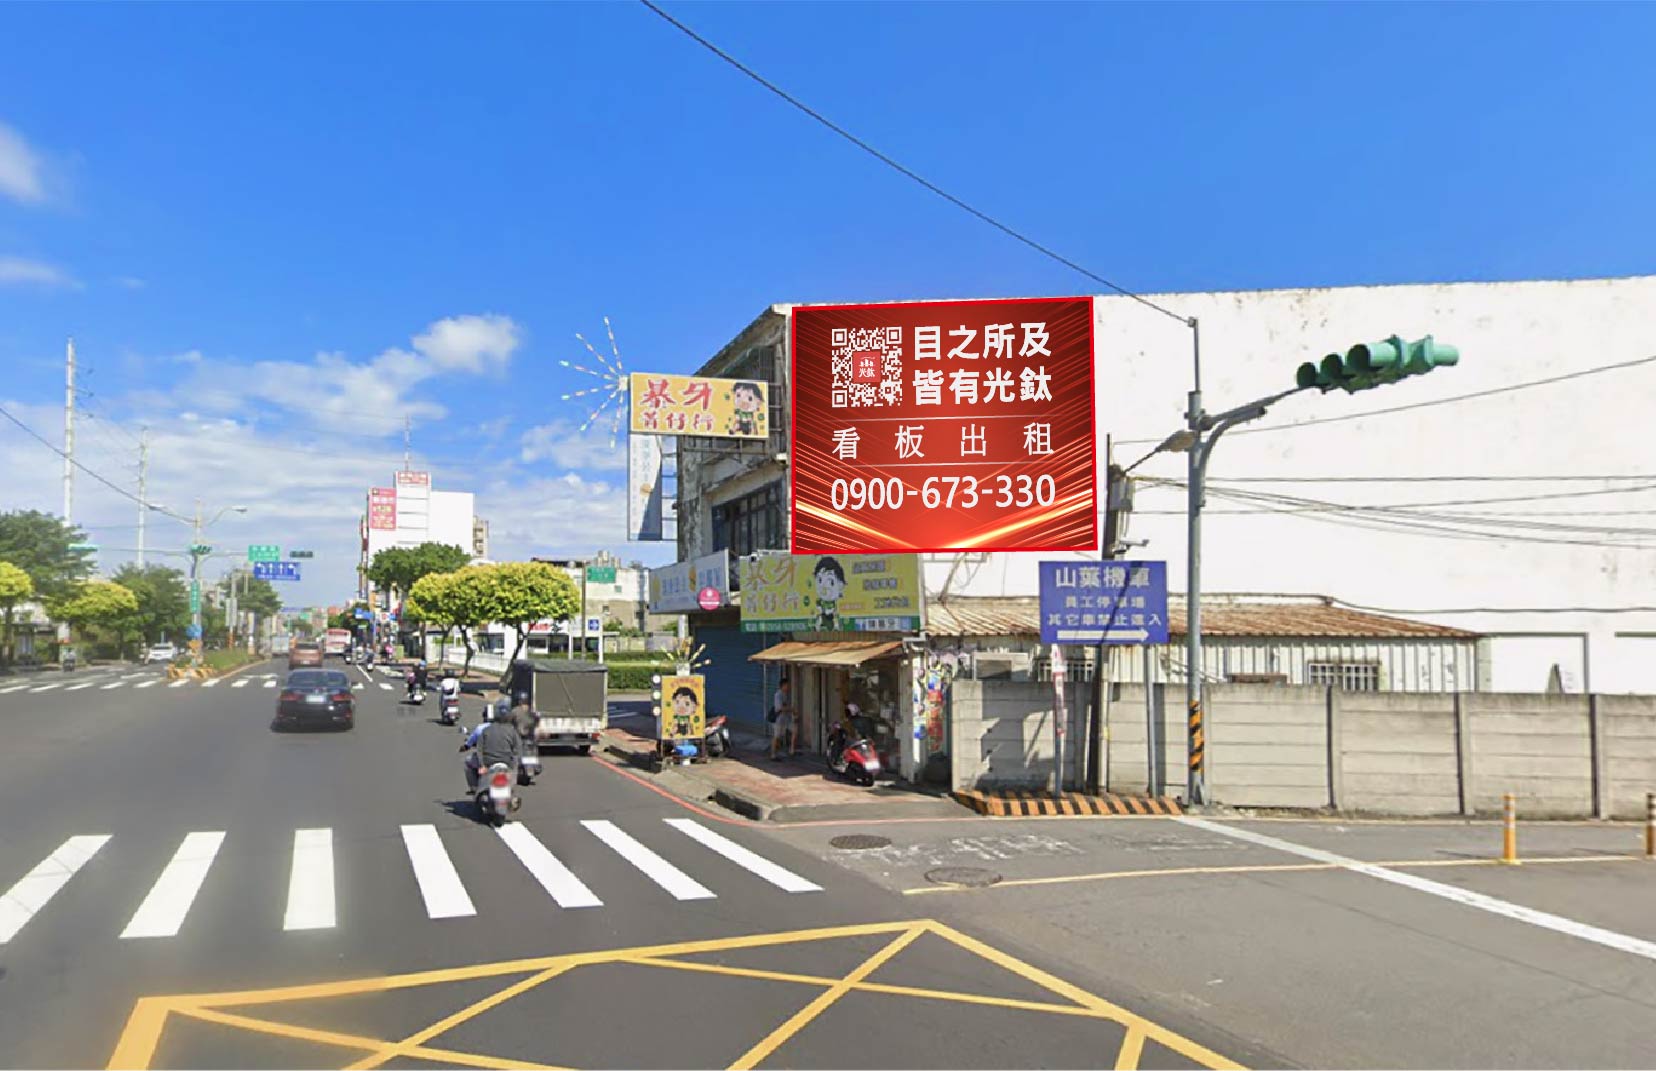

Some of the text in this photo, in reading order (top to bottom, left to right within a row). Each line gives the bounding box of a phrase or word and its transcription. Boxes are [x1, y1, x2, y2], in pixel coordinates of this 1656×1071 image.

[913, 321, 1052, 361] 目之所及
[911, 365, 1053, 406] 皆有光鈦
[831, 422, 1055, 460] 看板出租
[830, 474, 1056, 510] 0900-673-330
[1056, 566, 1150, 588] 山葉機車
